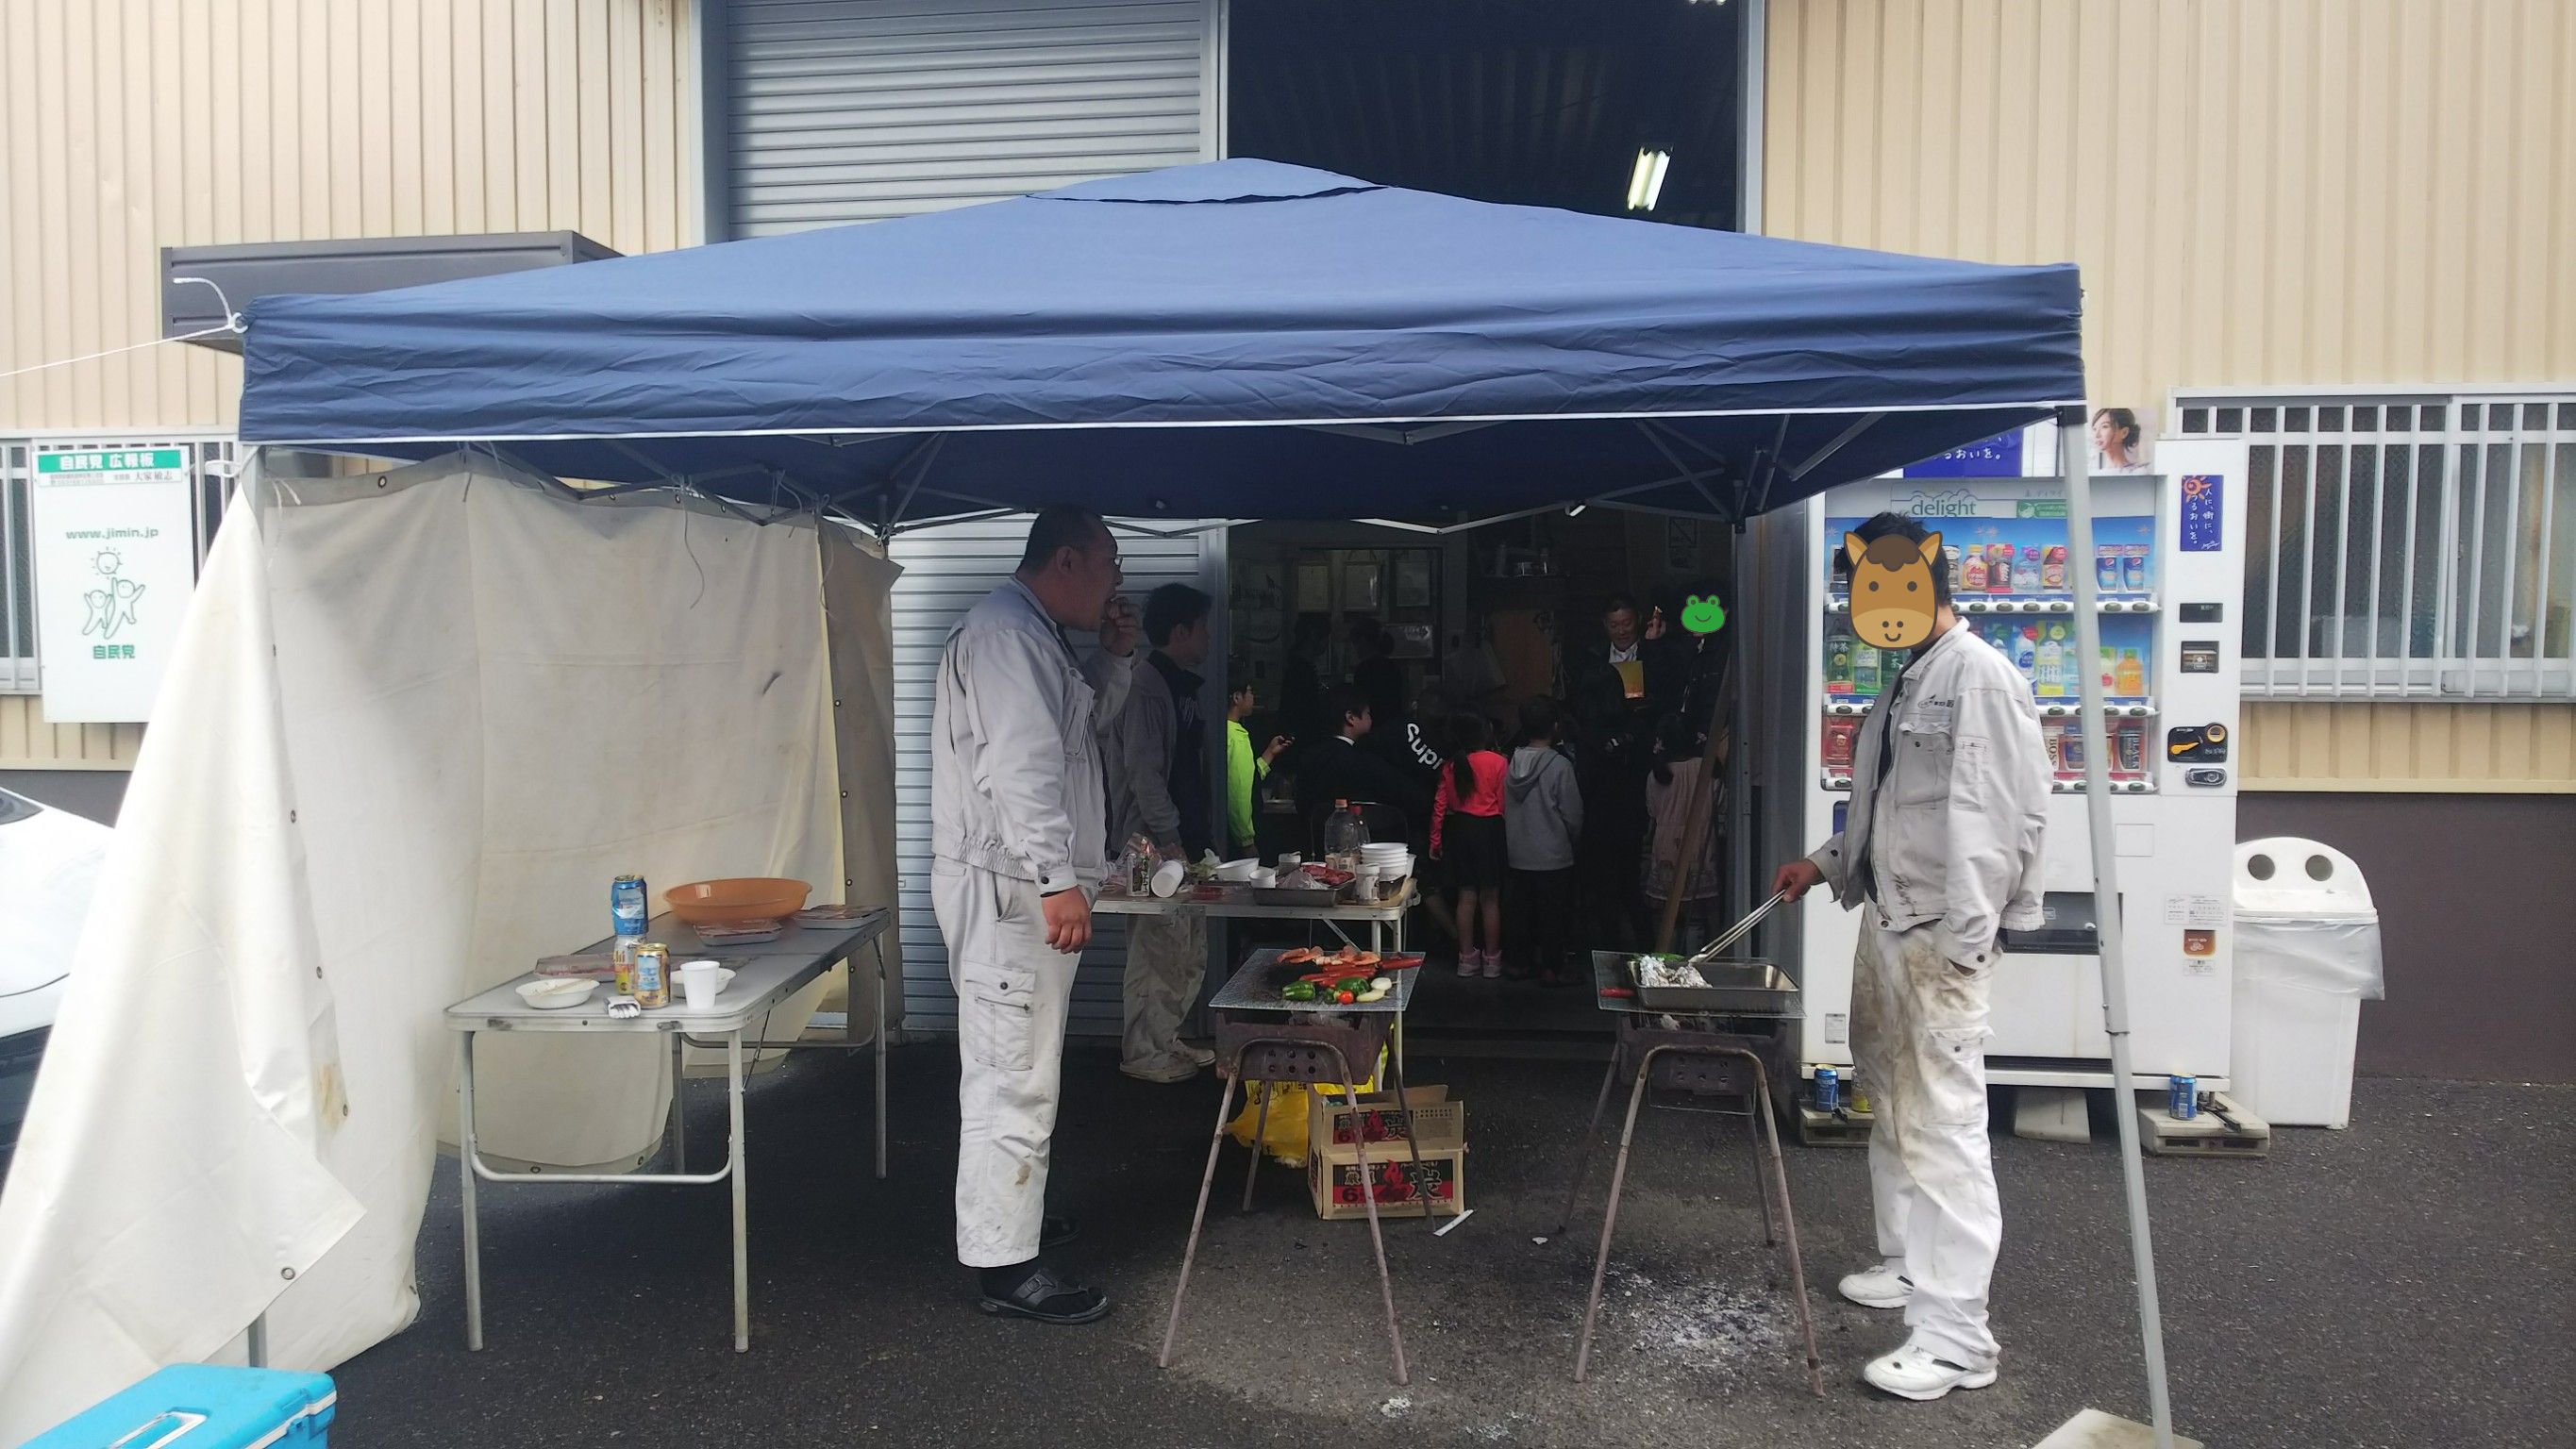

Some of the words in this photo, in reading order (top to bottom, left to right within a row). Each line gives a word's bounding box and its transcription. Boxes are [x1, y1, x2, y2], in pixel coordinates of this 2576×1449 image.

[59, 455, 103, 471] 自民党
[1911, 499, 1977, 518] delight
[65, 526, 159, 541] www.jimin.jp
[92, 644, 136, 660] 自民党
[2049, 738, 2058, 767] BOSS
